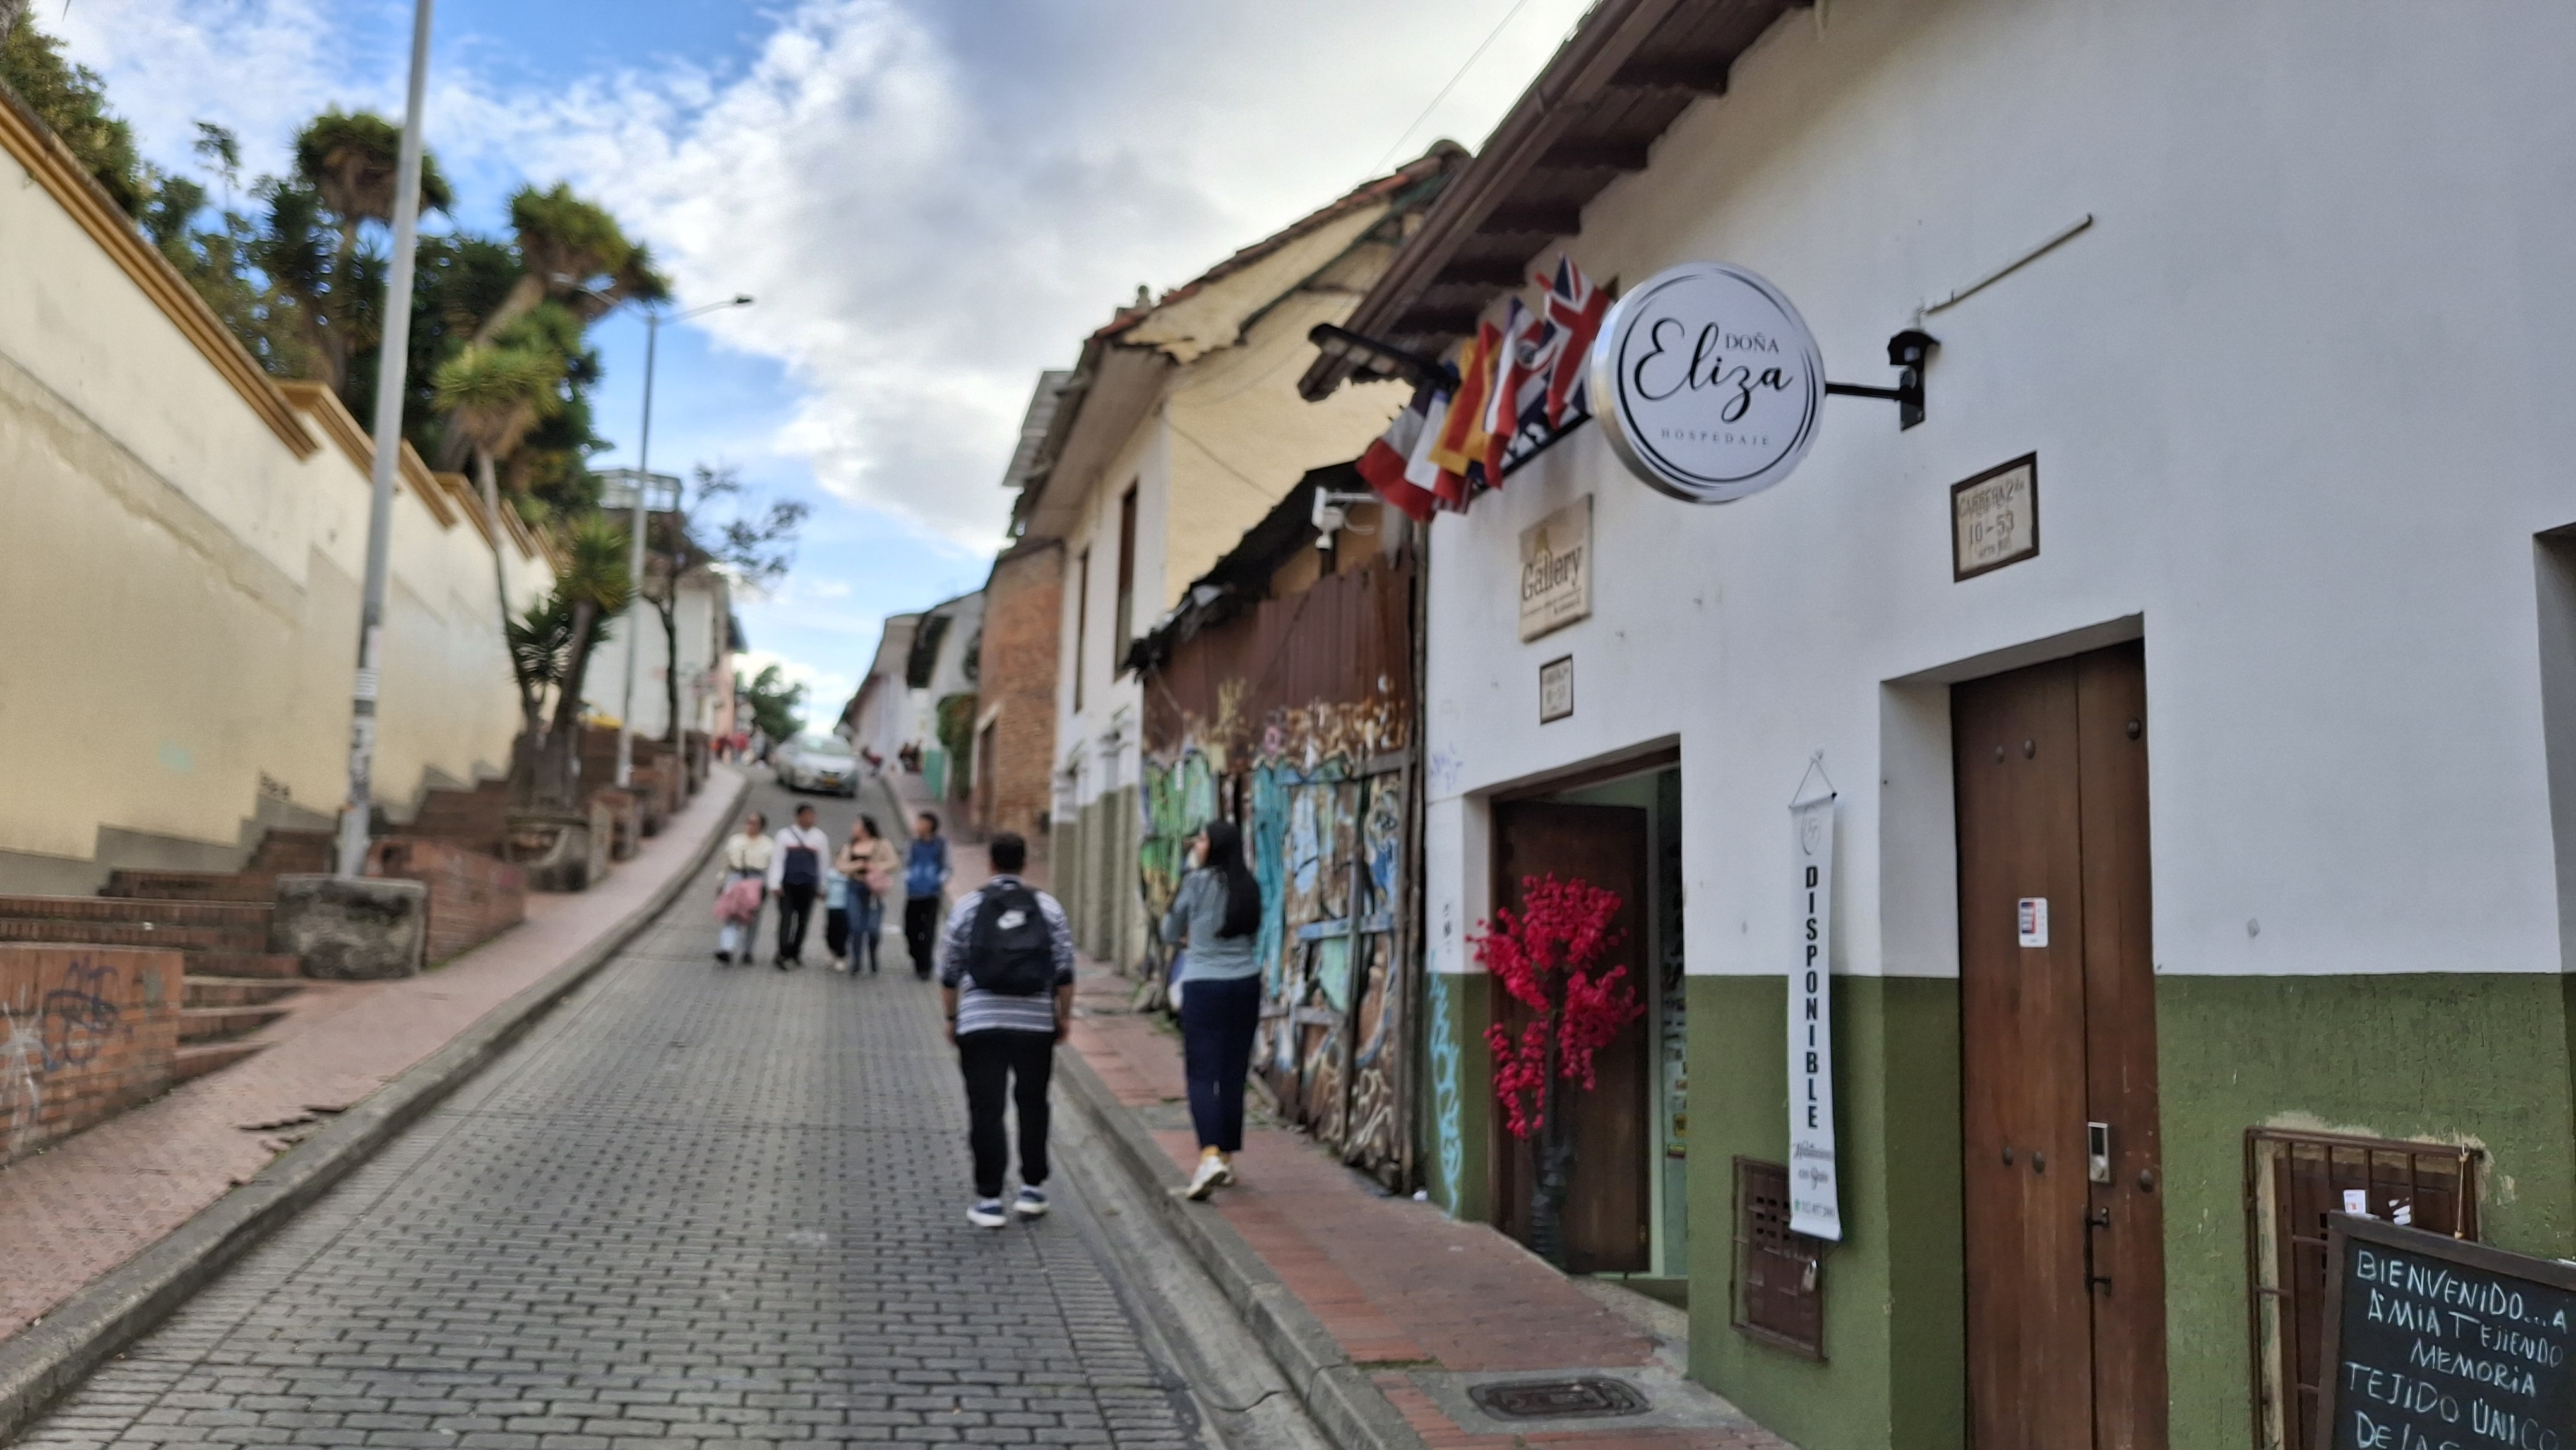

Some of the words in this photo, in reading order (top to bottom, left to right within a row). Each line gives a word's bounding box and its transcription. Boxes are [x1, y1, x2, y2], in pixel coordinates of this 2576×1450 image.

[1634, 317, 1794, 424] Eliza
[1726, 332, 1779, 354] DOÑA
[1661, 429, 1770, 446] HOSPEDAJE
[1522, 546, 1582, 601] Gallery
[1806, 866, 1819, 1129] DISPONIBLE
[2409, 1337, 2537, 1398] MEMORIA
[2448, 1310, 2563, 1369] TEJIENDO
[2344, 1362, 2460, 1423] TEJIDO
[2354, 1409, 2394, 1450] DE
